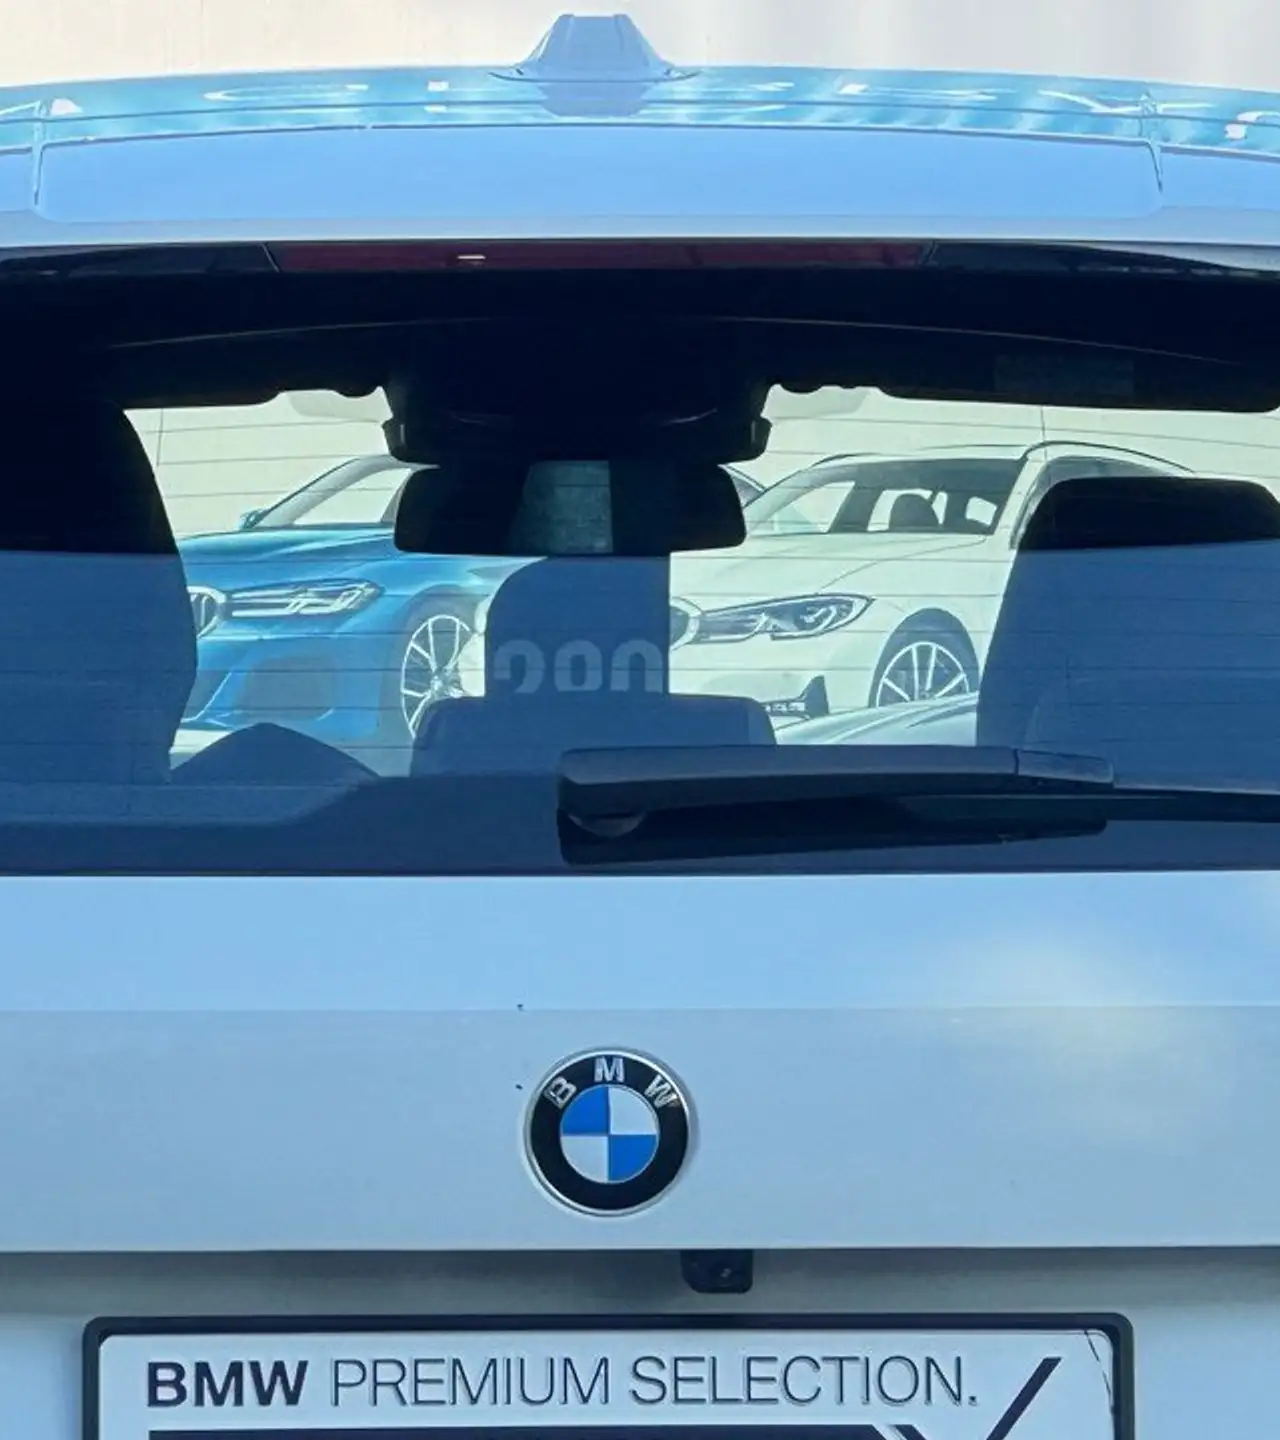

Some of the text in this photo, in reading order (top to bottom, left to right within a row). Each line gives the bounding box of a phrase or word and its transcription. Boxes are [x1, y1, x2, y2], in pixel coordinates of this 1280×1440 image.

[544, 1056, 682, 1109] BMW
[147, 1355, 978, 1407] BMW PREMIUM SELECTION.
